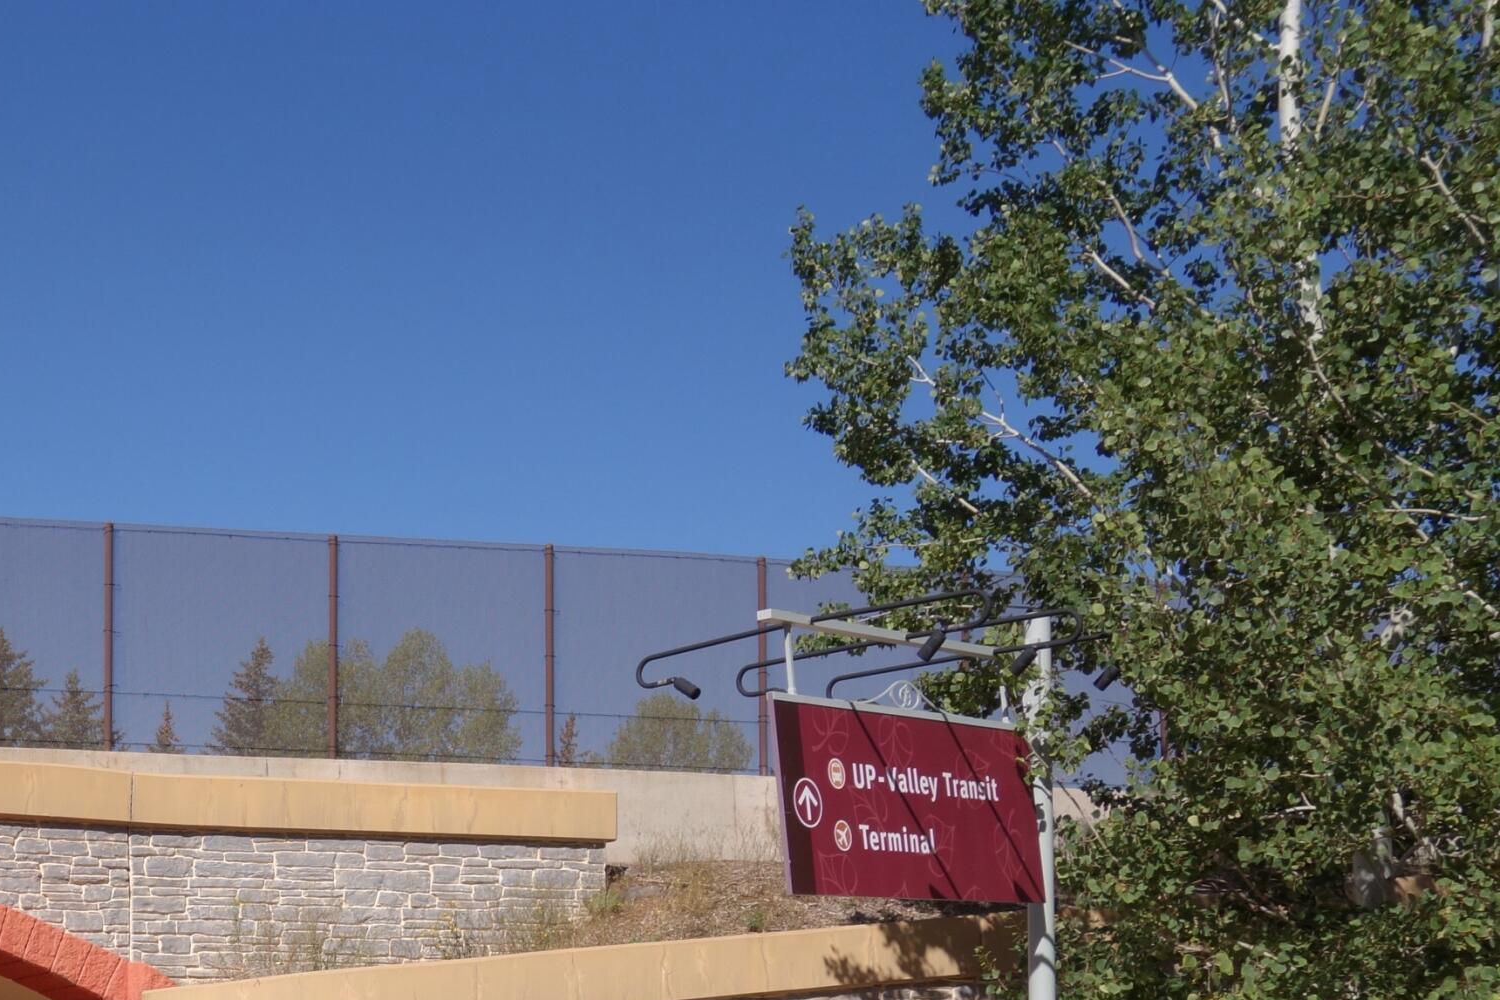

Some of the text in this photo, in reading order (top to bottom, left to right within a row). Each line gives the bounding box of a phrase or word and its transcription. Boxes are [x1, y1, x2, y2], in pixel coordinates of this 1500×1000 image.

[853, 763, 1000, 802] UP-Valley Transit
[859, 824, 936, 854] Terminal
